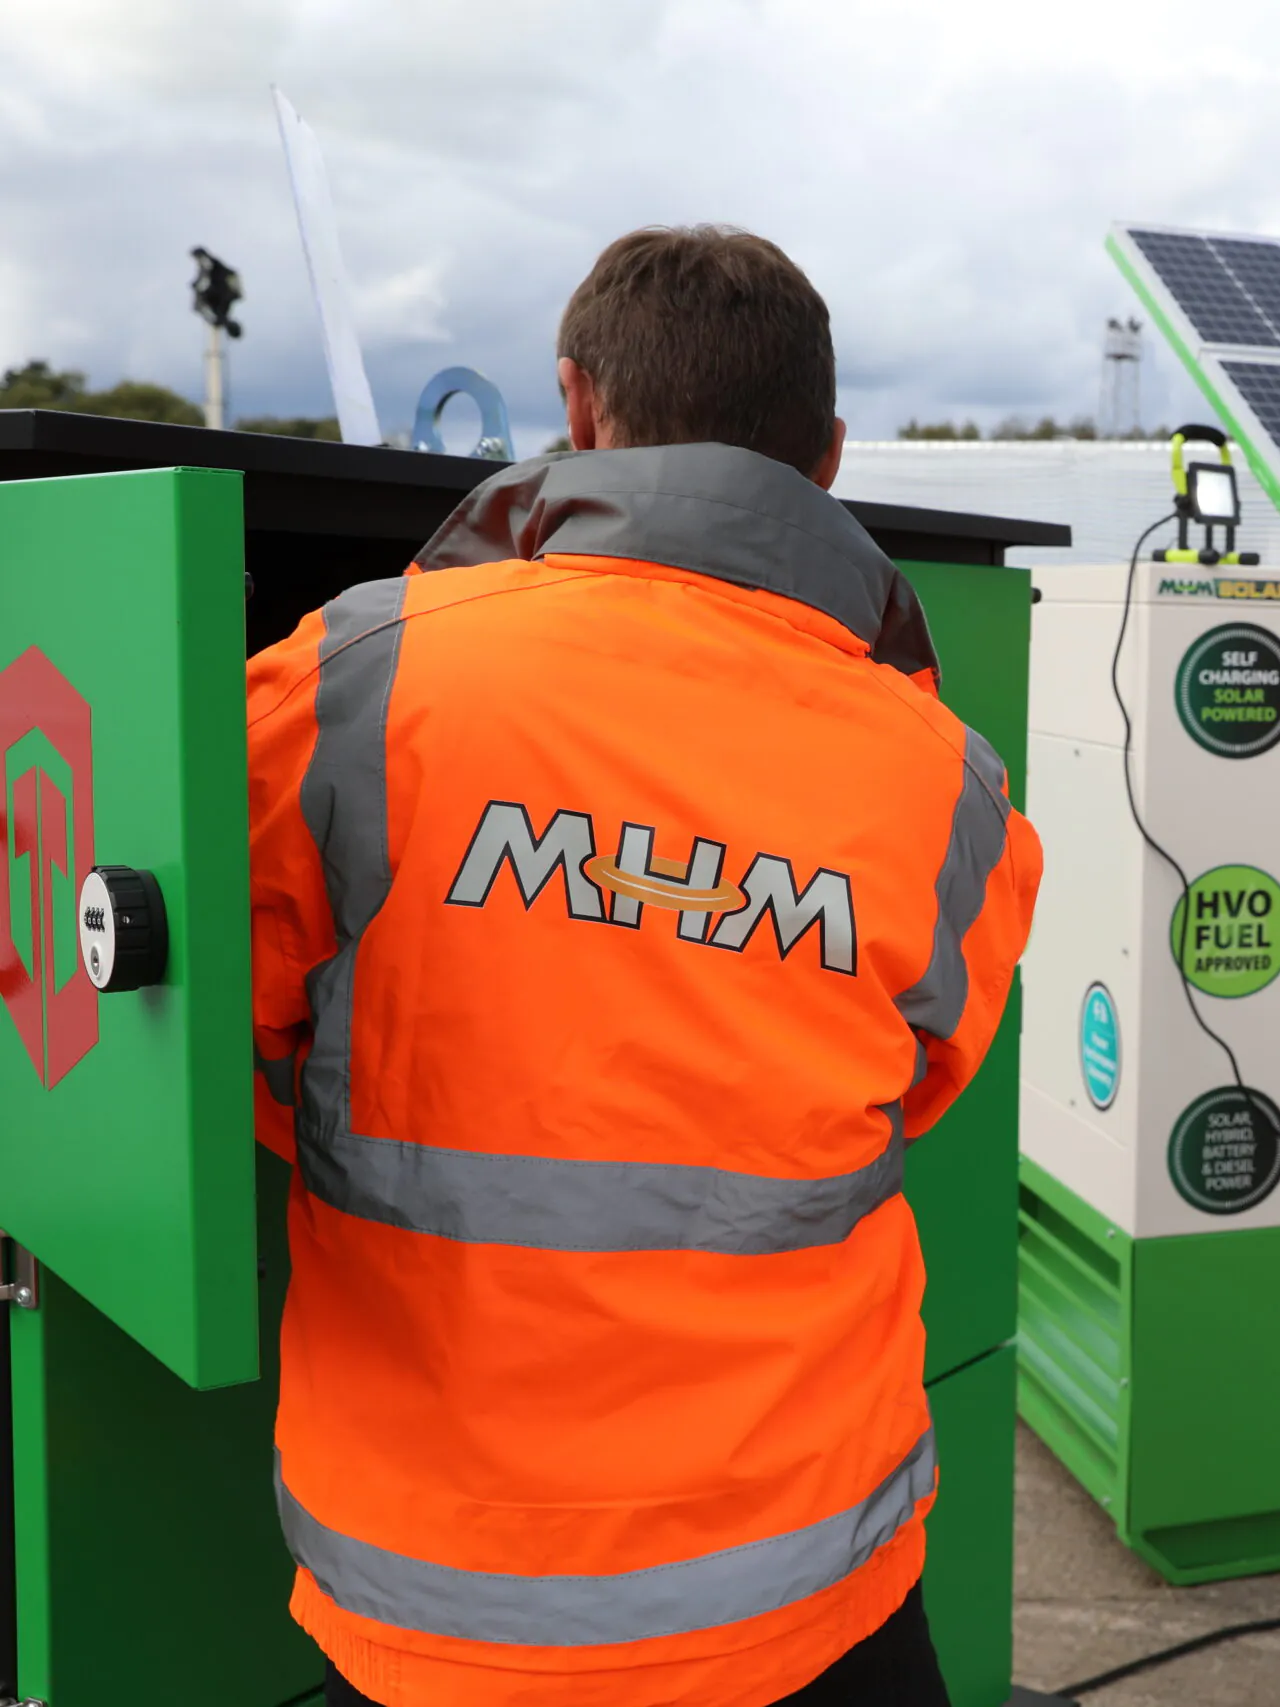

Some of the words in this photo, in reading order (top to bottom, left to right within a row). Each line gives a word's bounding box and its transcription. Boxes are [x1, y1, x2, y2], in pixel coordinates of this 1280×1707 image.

[1221, 650, 1259, 667] SELF
[1198, 669, 1280, 686] CHARGING
[1213, 688, 1265, 704] SOLAR
[1201, 707, 1277, 722] POWERED
[443, 799, 857, 977] MHM
[1196, 889, 1273, 919] HVO
[1195, 922, 1272, 951] FUEL
[1194, 954, 1273, 974] APPROVED
[1202, 1142, 1258, 1160] BATTERY
[1201, 1161, 1213, 1176] &
[1214, 1159, 1257, 1175] DIESEL
[1205, 1174, 1254, 1191] POWER
